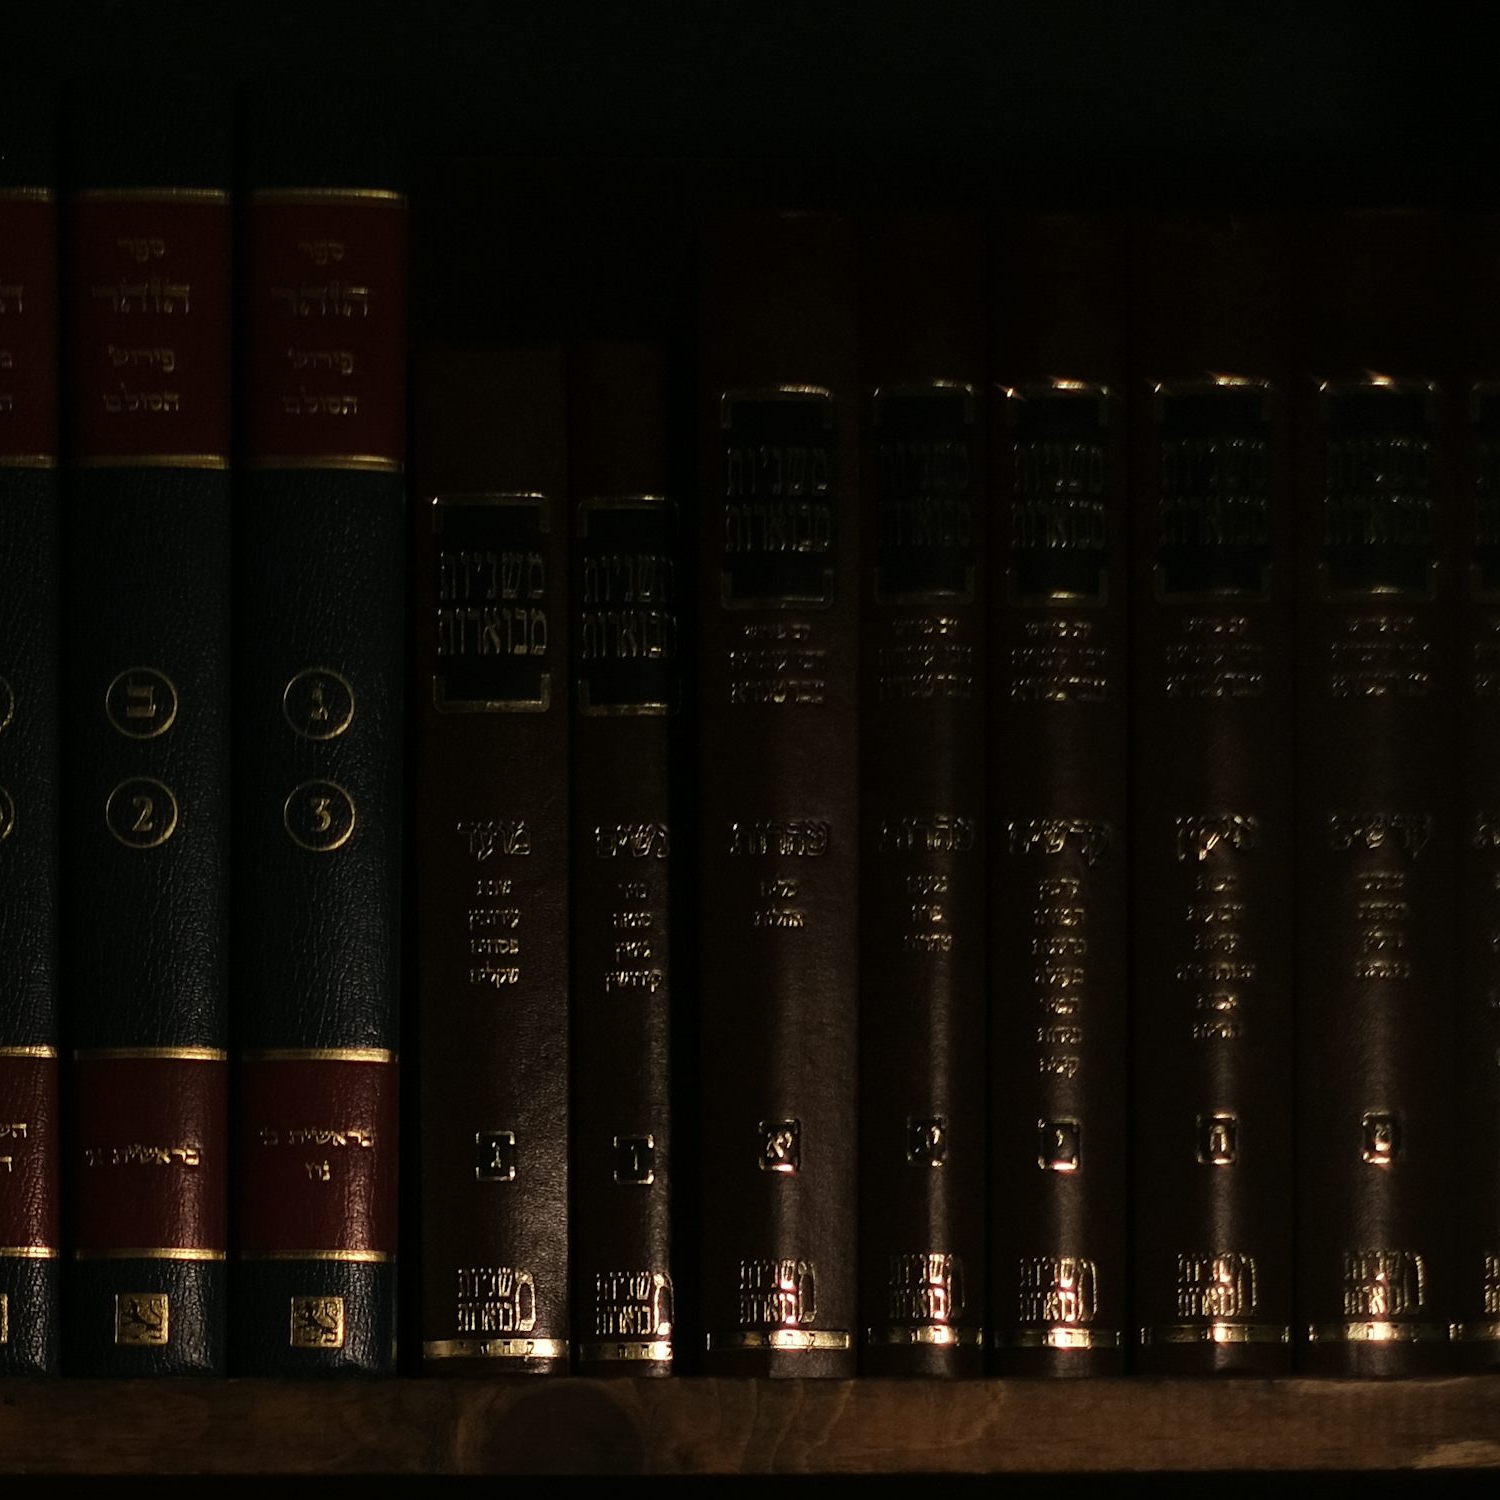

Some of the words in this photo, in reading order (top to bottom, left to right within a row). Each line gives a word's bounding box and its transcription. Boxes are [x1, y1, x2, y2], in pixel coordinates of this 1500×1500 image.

[438, 550, 546, 601] משניות
[437, 607, 548, 656] מבוארות
[131, 796, 153, 832] 2
[310, 797, 331, 832] 3
